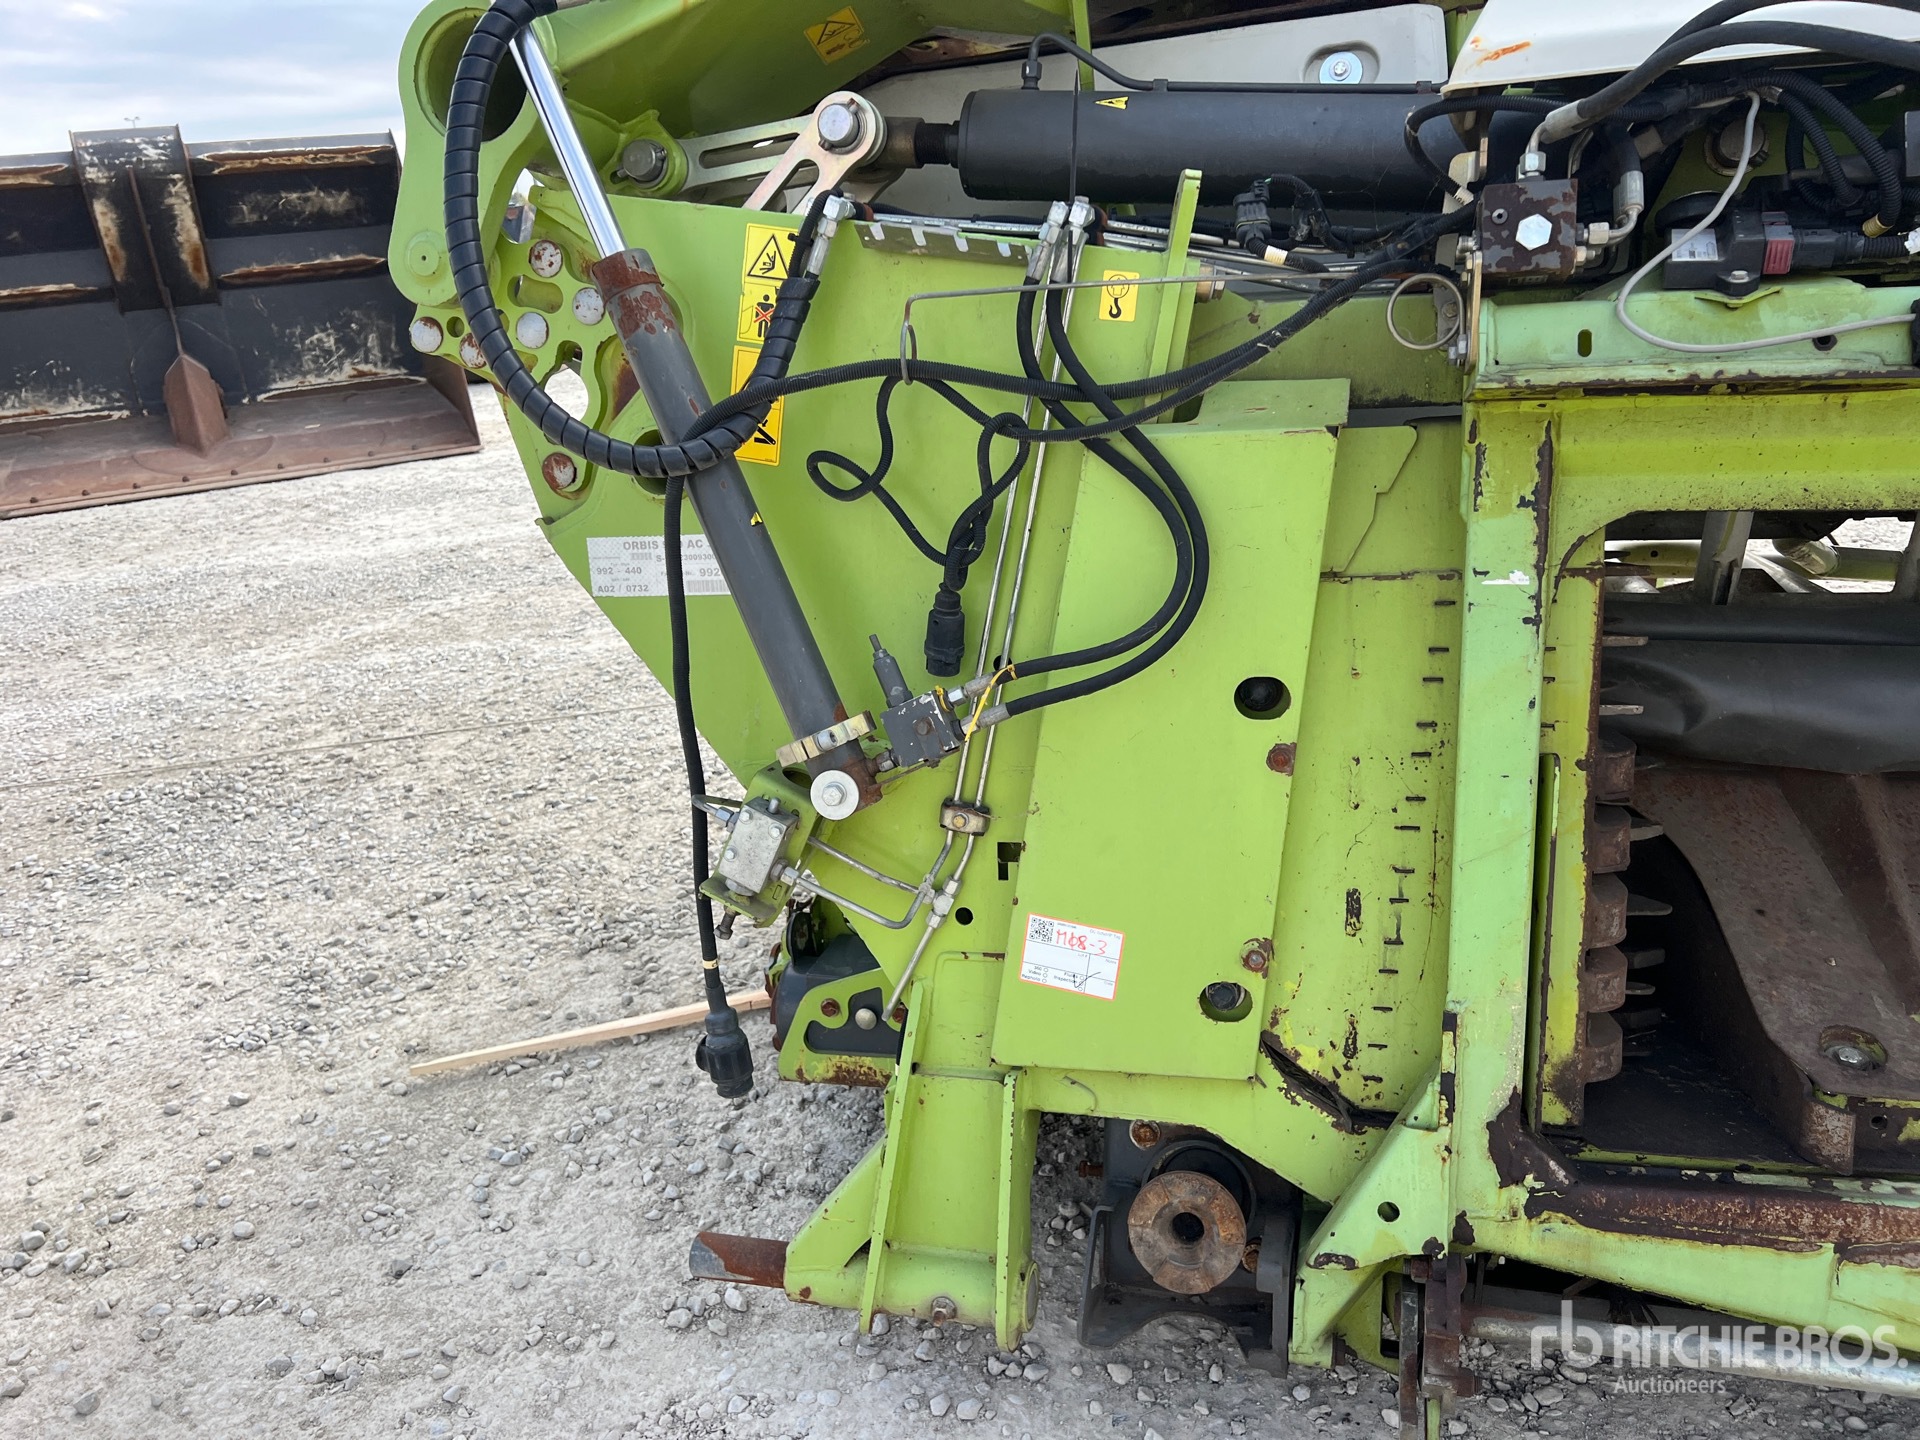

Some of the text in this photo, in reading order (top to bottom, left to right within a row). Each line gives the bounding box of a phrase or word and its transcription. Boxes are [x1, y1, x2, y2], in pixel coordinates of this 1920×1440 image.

[623, 540, 659, 550] ORBIS
[687, 540, 703, 549] AC
[596, 567, 614, 575] 992
[625, 567, 642, 575] 440
[598, 585, 615, 593] A02
[626, 584, 649, 592] 0732
